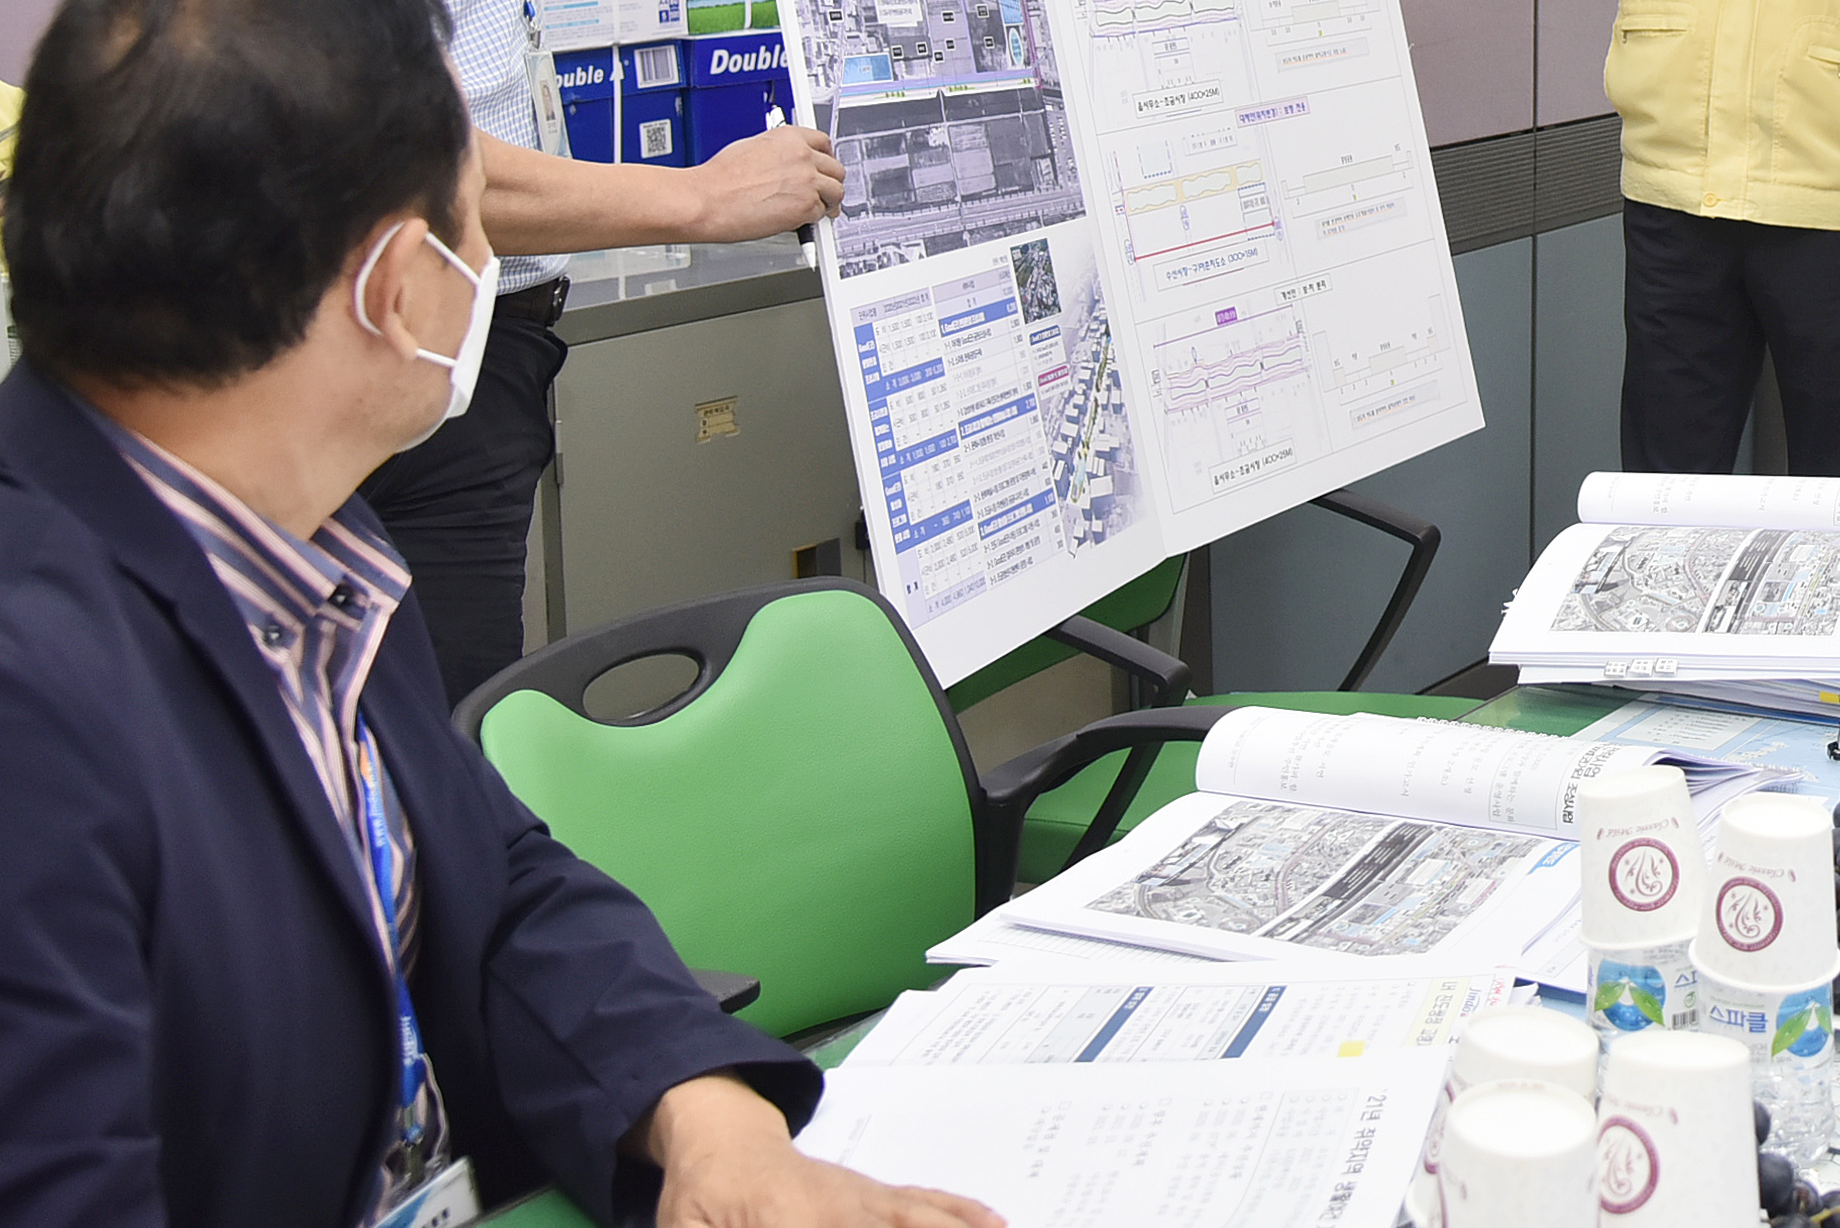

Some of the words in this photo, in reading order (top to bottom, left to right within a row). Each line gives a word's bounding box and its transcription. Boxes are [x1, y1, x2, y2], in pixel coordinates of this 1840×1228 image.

[1563, 783, 1577, 823] 조성사업
[1635, 819, 1669, 834] Classic
[1748, 865, 1785, 878] Classic
[1462, 987, 1481, 1012] Jindo
[1709, 1005, 1768, 1033] 스파클
[1416, 1029, 1438, 1046] 고령
[1342, 1127, 1377, 1175] 취약지역
